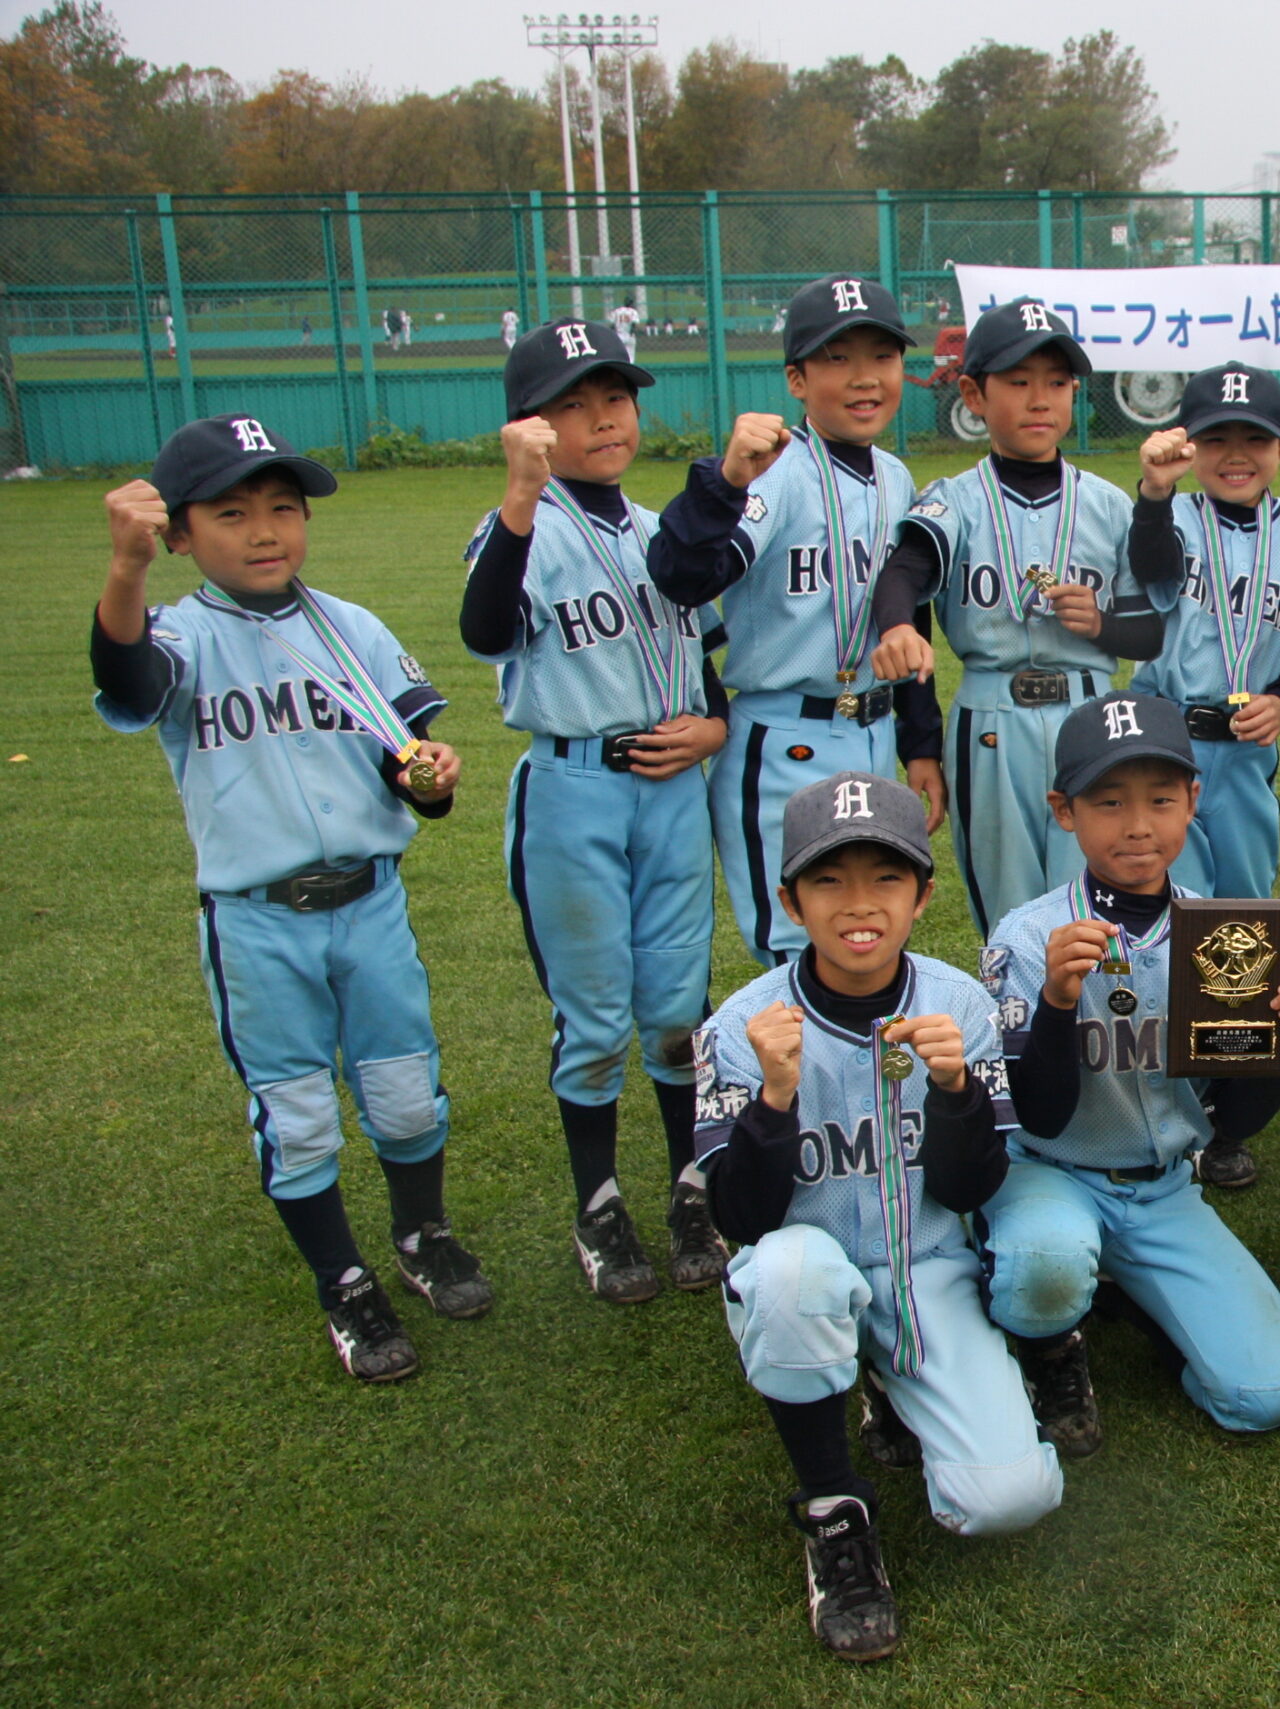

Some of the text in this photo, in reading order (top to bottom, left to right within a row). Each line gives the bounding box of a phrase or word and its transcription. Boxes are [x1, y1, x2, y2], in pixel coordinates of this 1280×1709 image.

[832, 280, 868, 313] H
[1020, 303, 1052, 331] H
[556, 323, 597, 360] H
[1221, 371, 1250, 404] H
[231, 418, 276, 453] H
[552, 582, 699, 652] HOR
[1103, 700, 1144, 740] H
[833, 780, 874, 820] H
[793, 1109, 924, 1186] OME
